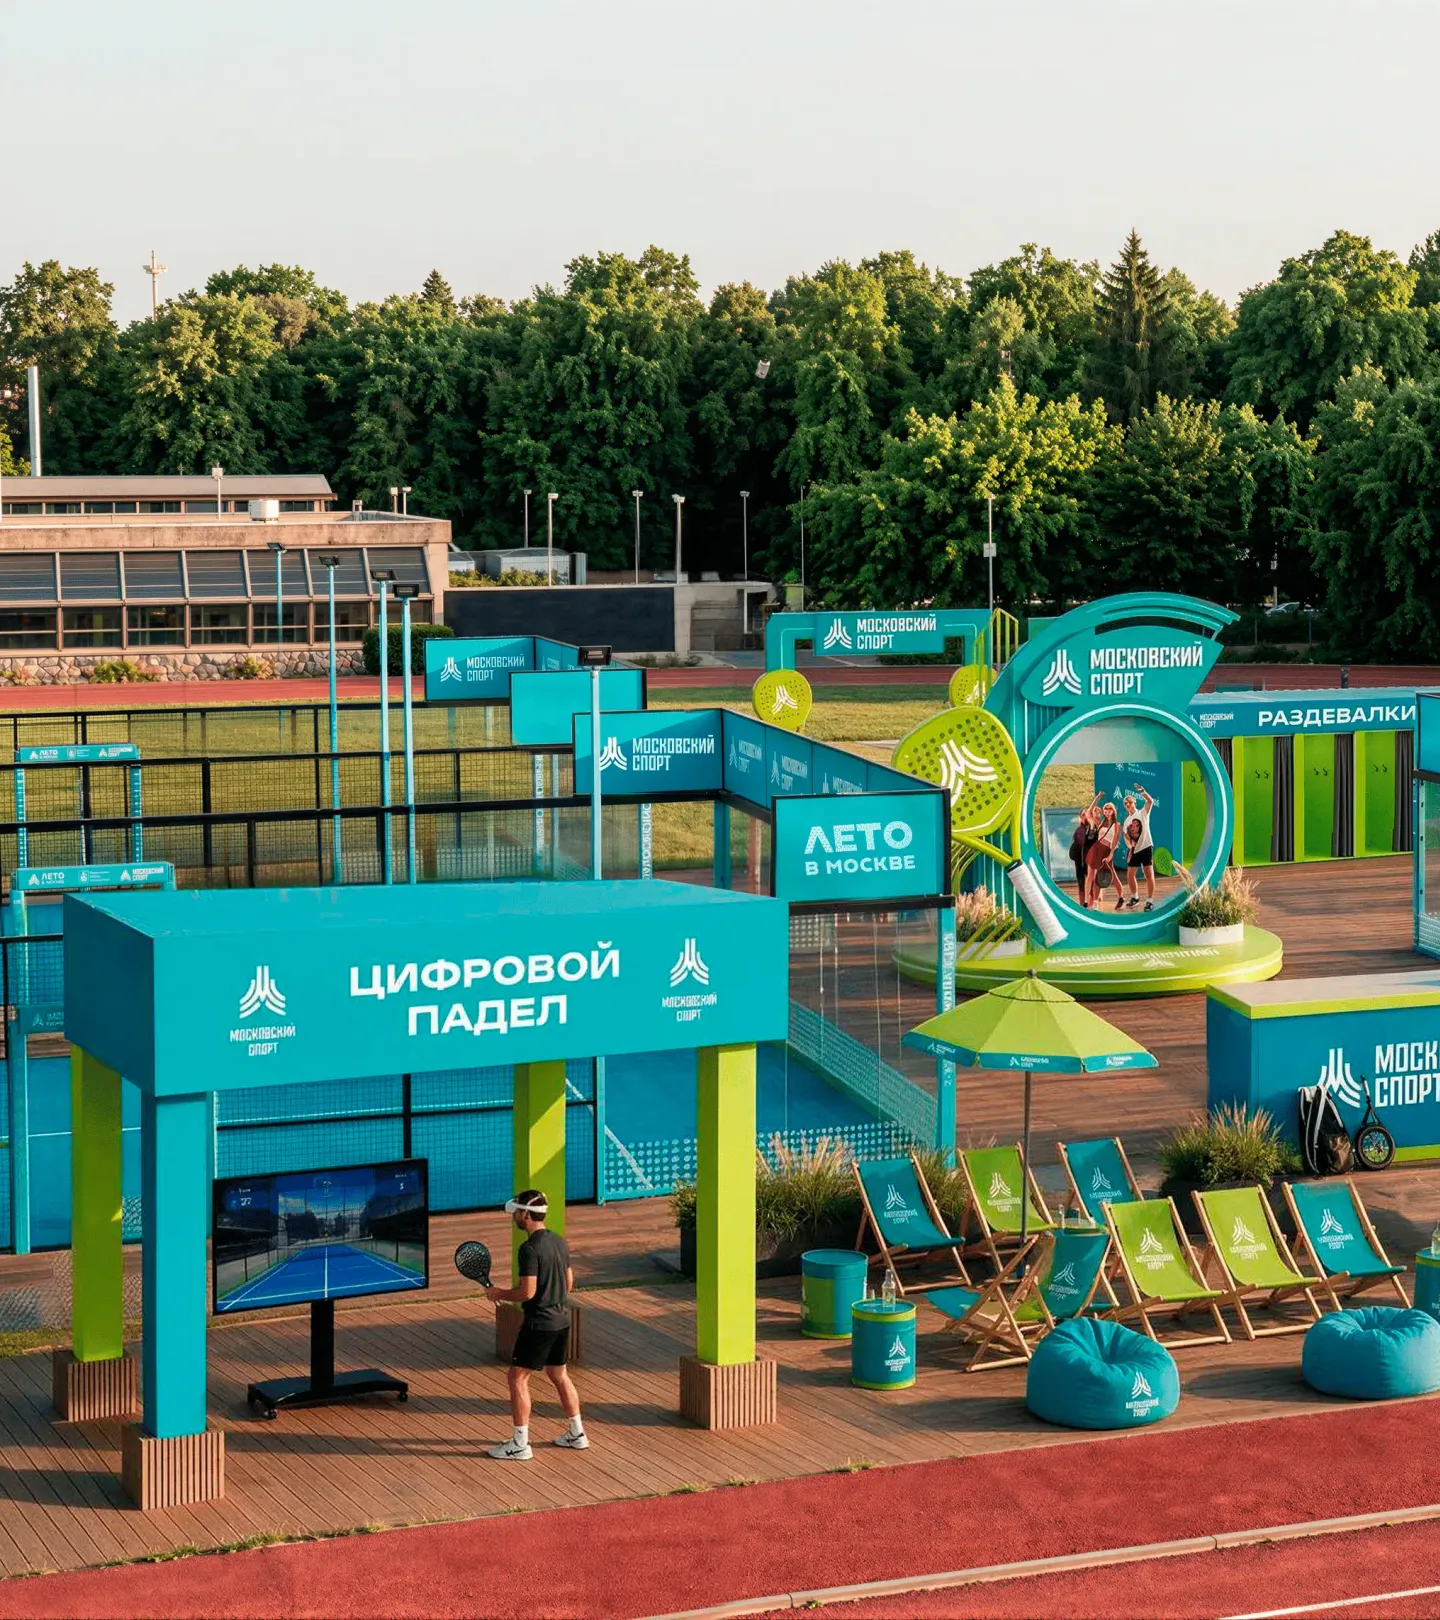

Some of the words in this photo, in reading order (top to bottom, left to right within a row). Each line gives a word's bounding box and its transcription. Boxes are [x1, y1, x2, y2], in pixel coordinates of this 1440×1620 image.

[857, 614, 936, 633] МОСКОВСКИЙ
[857, 635, 894, 649] СПОРТ
[466, 654, 525, 667] МОСКОВСКИЙ
[1090, 640, 1203, 670] МОСКОВСКИЙ
[467, 670, 494, 681] СПОРТ
[1090, 672, 1144, 695] СПОРТ
[1258, 705, 1416, 728] РАЗДЕВАЛКИ
[632, 734, 715, 754] МОСКОВСКИЙ
[632, 755, 671, 771] СПОРТ
[804, 820, 913, 855] ЛЕТО
[805, 861, 819, 875] В
[826, 855, 916, 874] МОСКВЕ
[350, 940, 620, 1000] ЦИФРОВОЙ
[408, 994, 568, 1036] ПАДЕЛ
